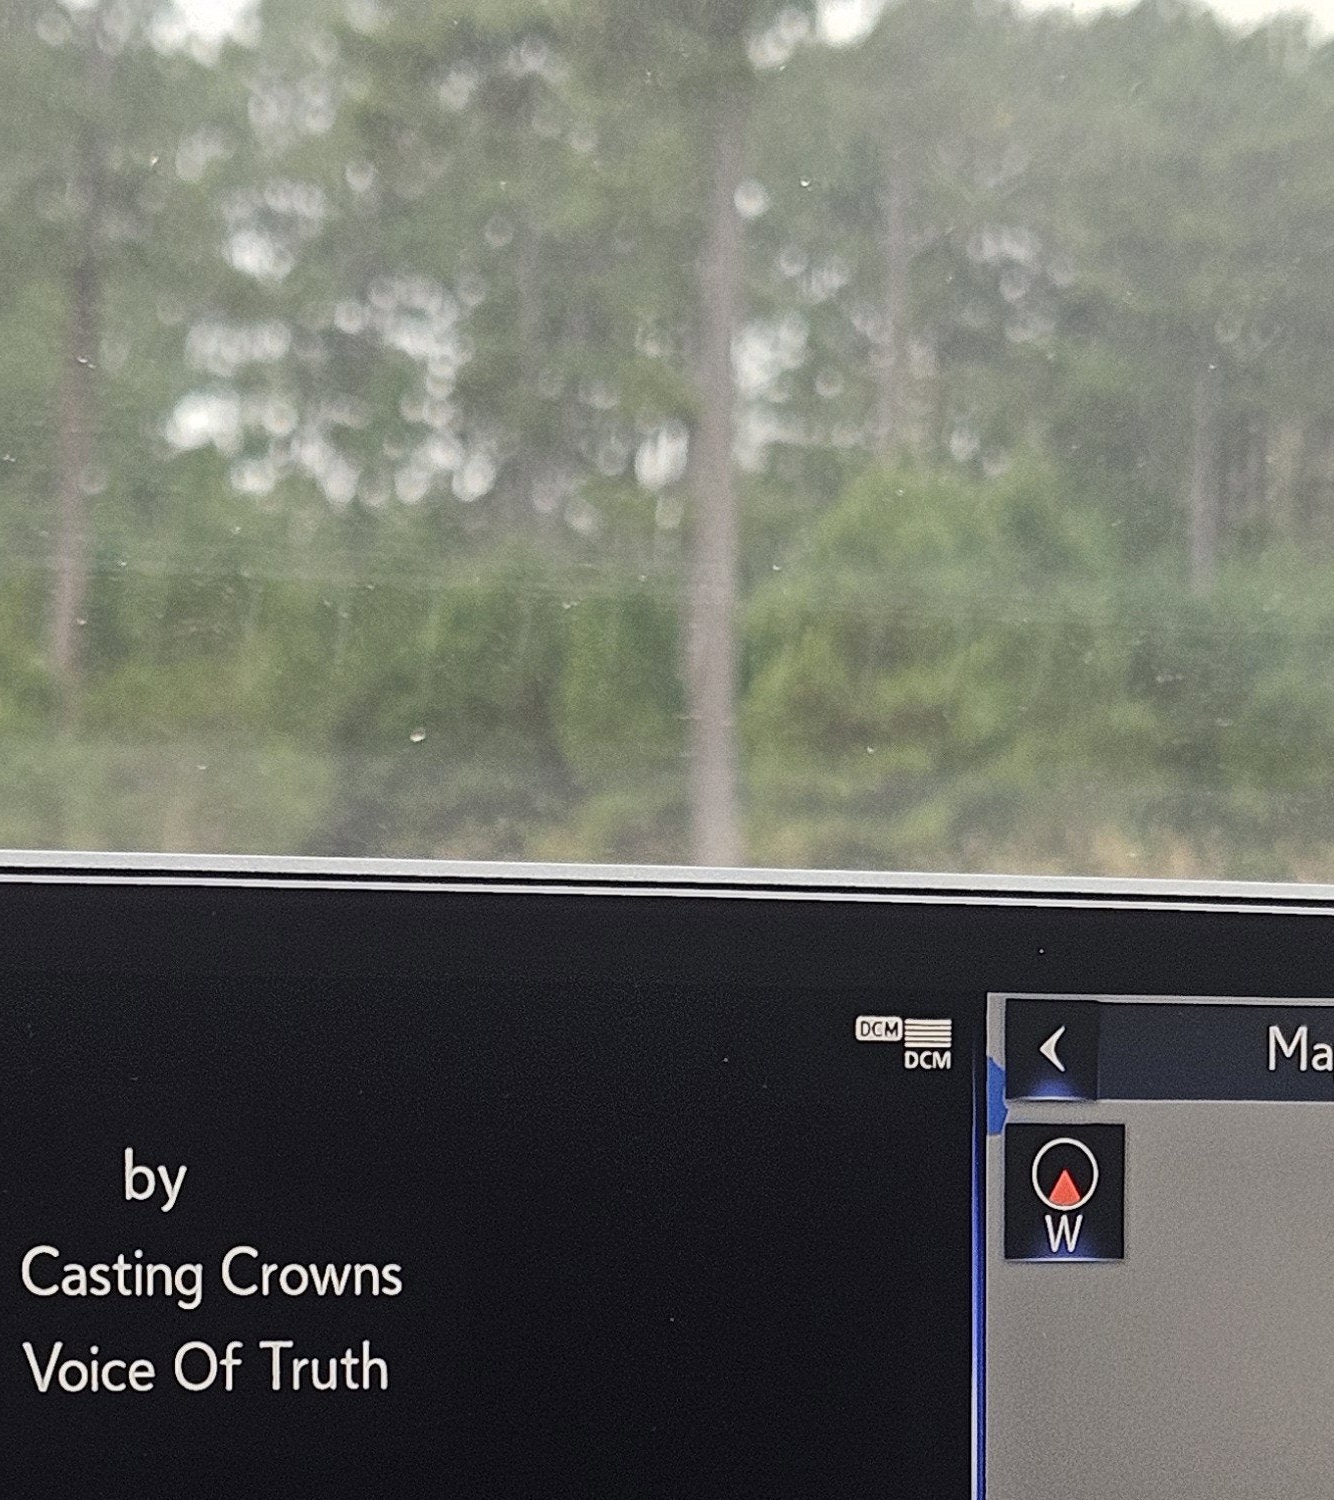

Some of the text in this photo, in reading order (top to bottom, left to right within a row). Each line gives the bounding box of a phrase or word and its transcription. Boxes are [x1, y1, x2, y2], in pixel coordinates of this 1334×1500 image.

[860, 1020, 899, 1038] DCM
[904, 1050, 952, 1070] DCM
[124, 1147, 188, 1212] by
[1045, 1214, 1084, 1253] W
[21, 1245, 404, 1310] Casting Crowns
[22, 1340, 389, 1392] Voice Of Truth
